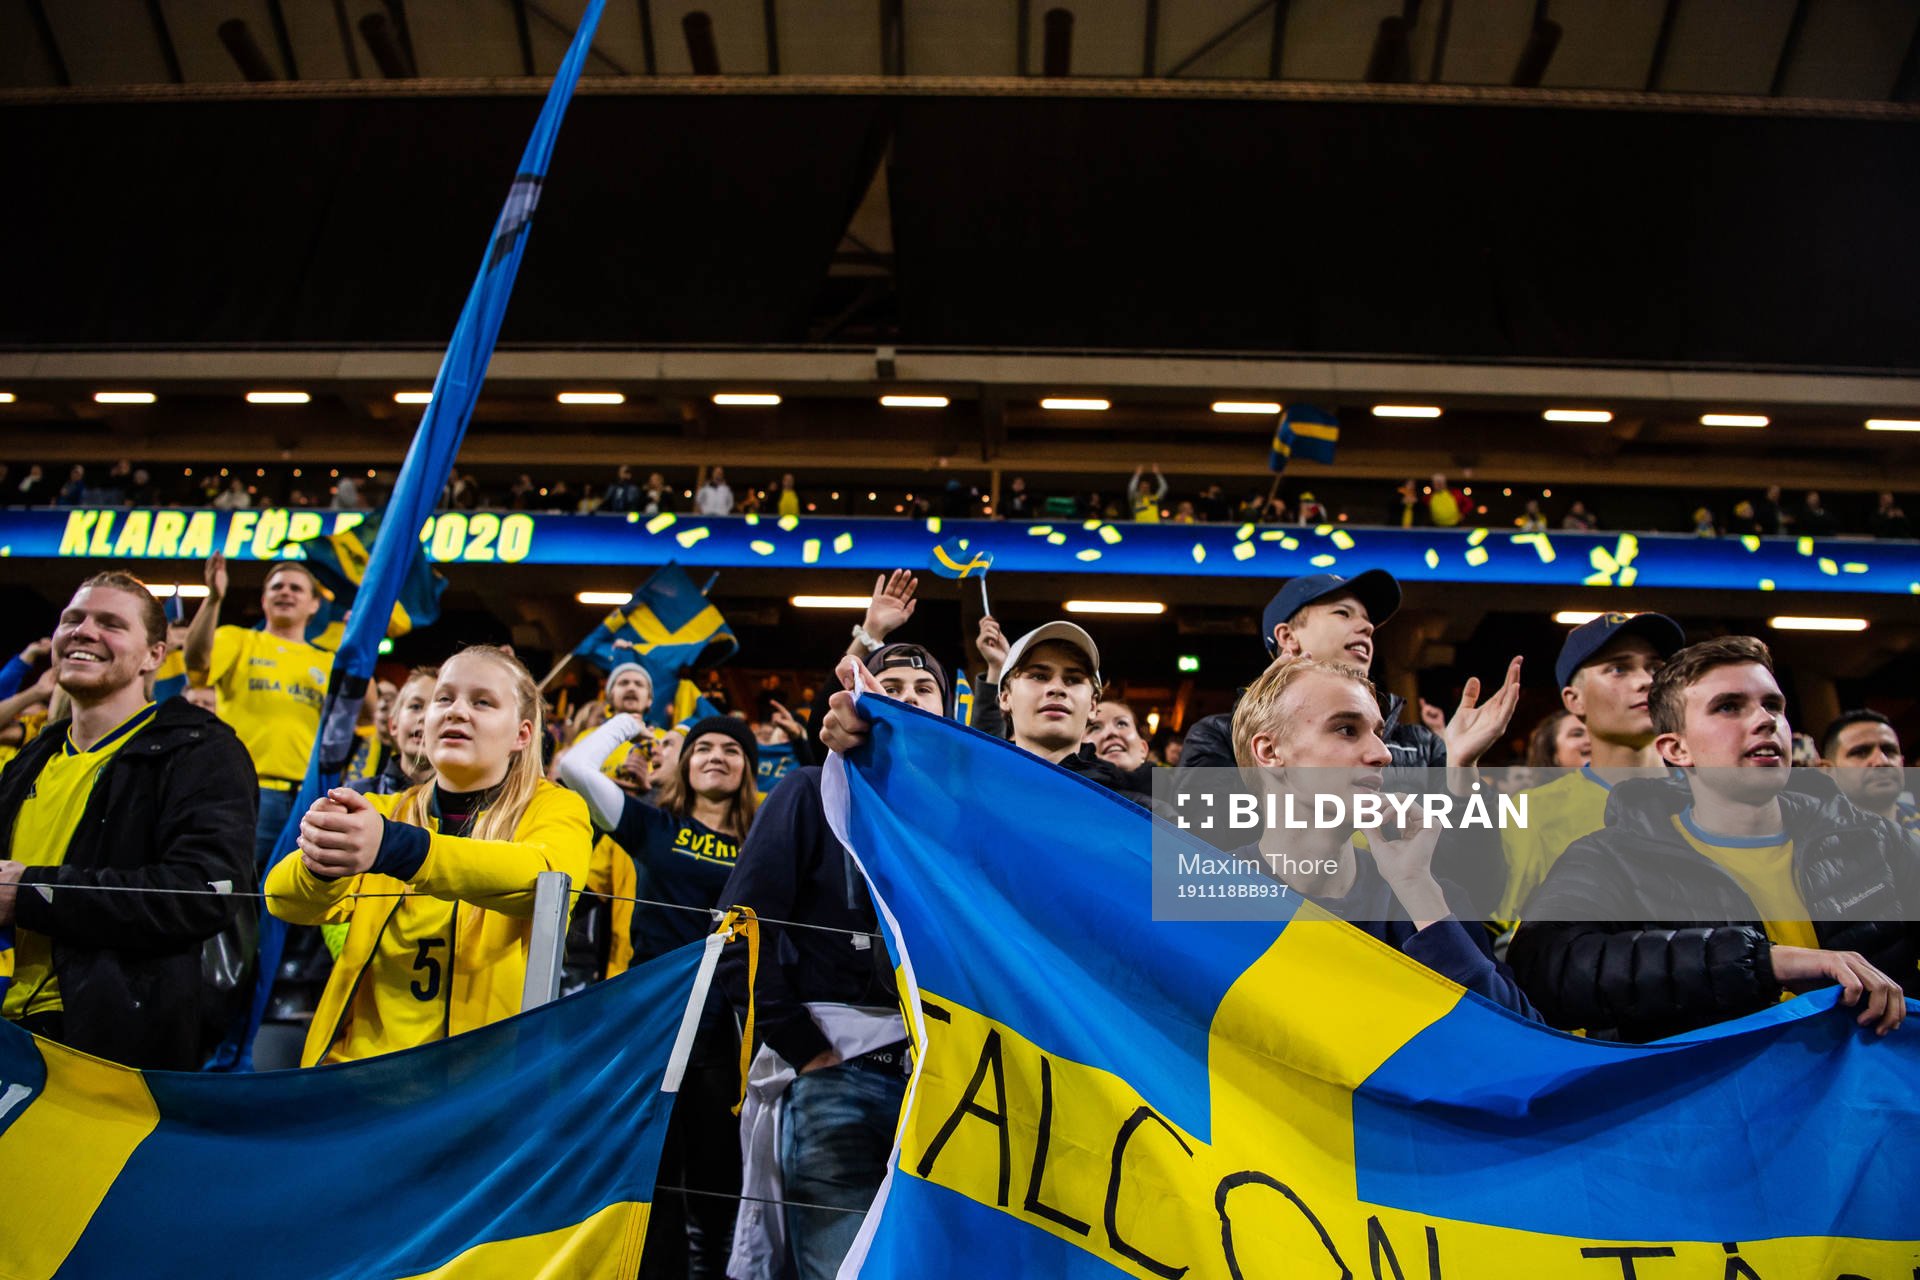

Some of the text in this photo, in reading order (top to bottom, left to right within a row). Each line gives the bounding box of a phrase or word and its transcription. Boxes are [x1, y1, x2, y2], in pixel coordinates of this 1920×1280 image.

[58, 509, 217, 557] KLARA
[418, 512, 535, 563] 020
[674, 828, 742, 858] SVERI
[410, 938, 446, 1001] 5
[917, 1000, 1442, 1280] ALCO
